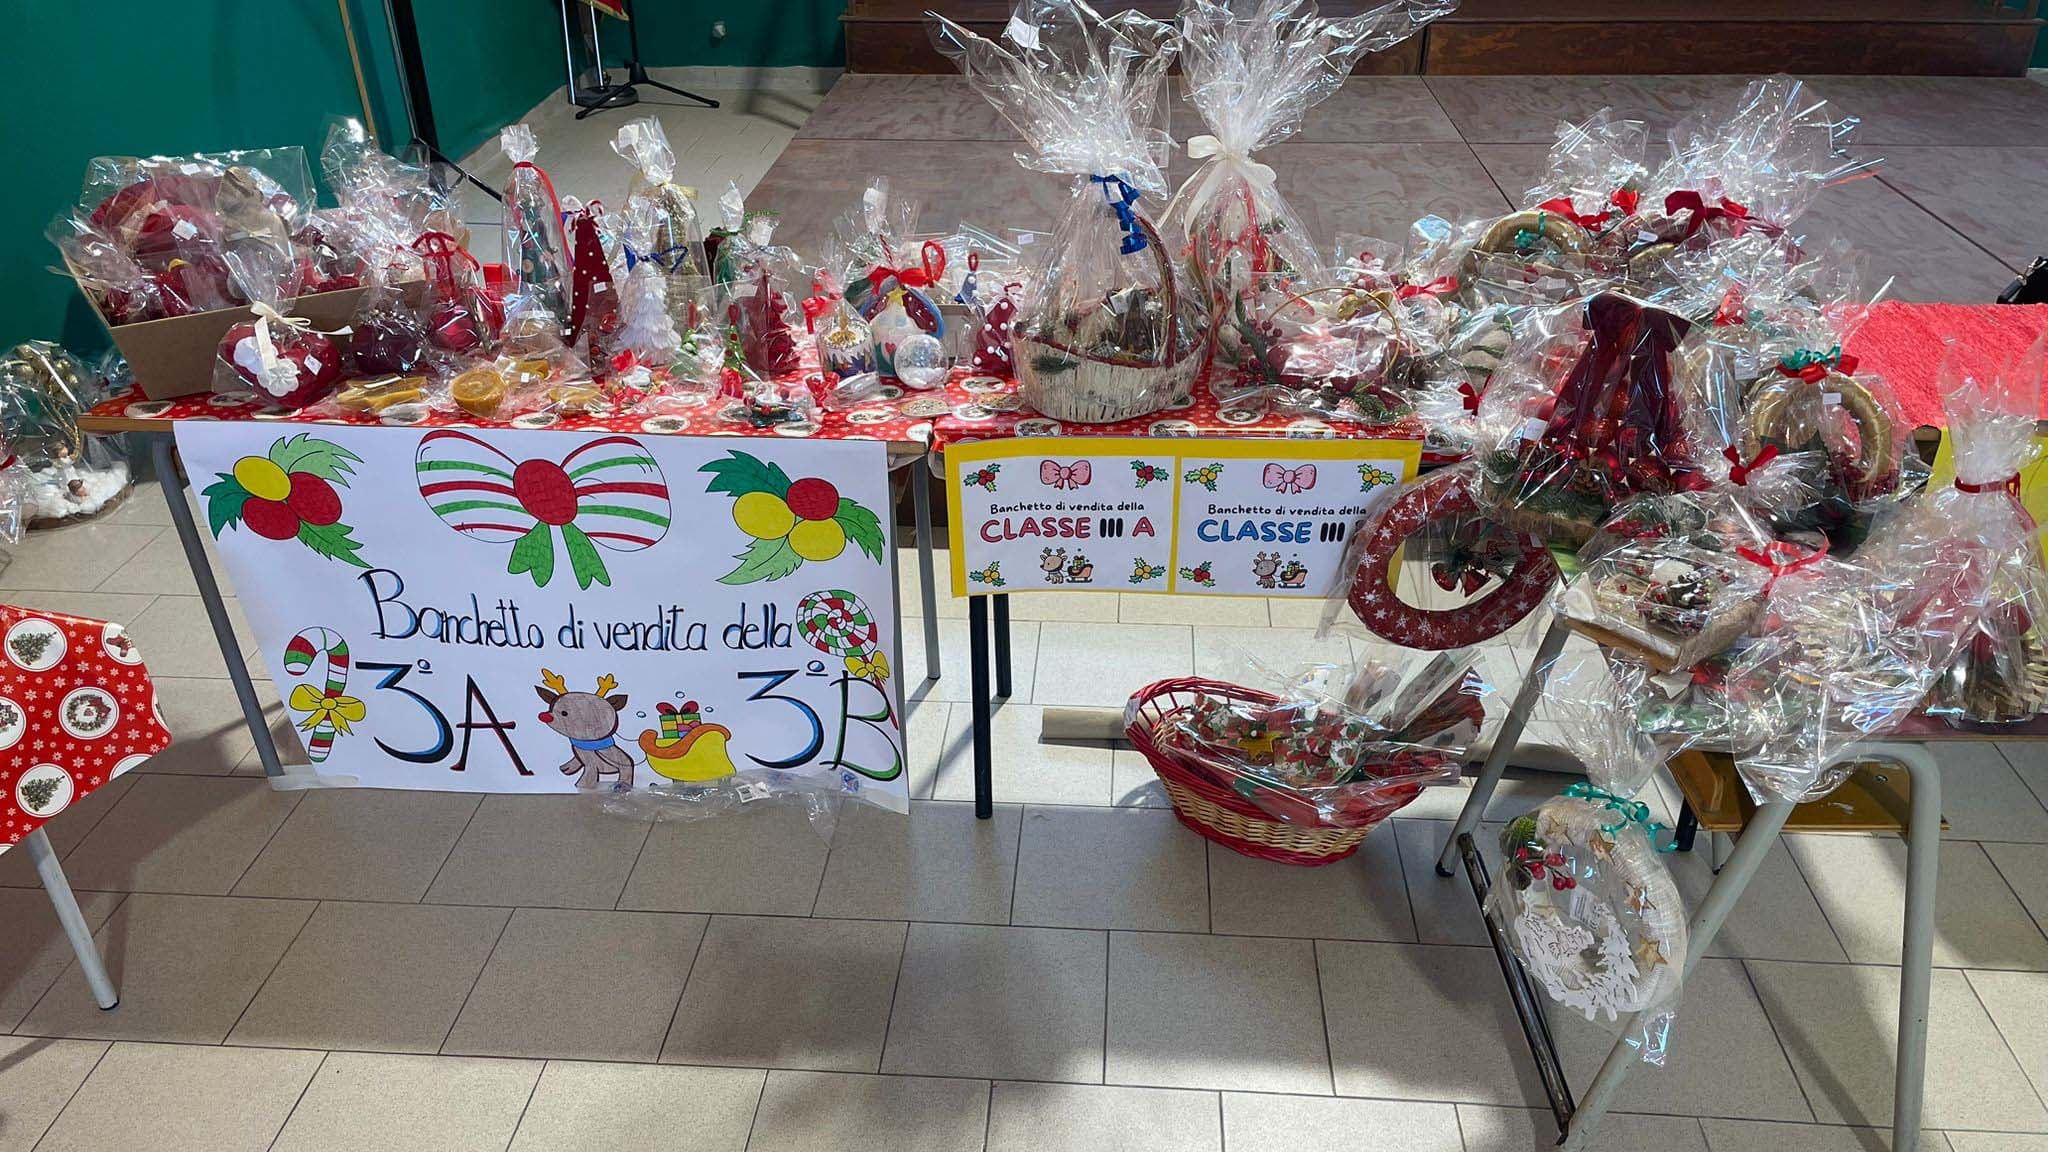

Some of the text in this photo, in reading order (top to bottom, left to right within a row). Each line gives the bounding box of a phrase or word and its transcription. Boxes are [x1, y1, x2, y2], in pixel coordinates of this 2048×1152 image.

[990, 501, 1145, 515] Banchetto di vendita della
[1207, 503, 1367, 516] Banchetto di vendita della
[980, 516, 1155, 543] CLASSE III A
[1197, 519, 1313, 544] CLASSE
[1320, 522, 1346, 543] III
[358, 568, 792, 650] Banchetto di vendita della
